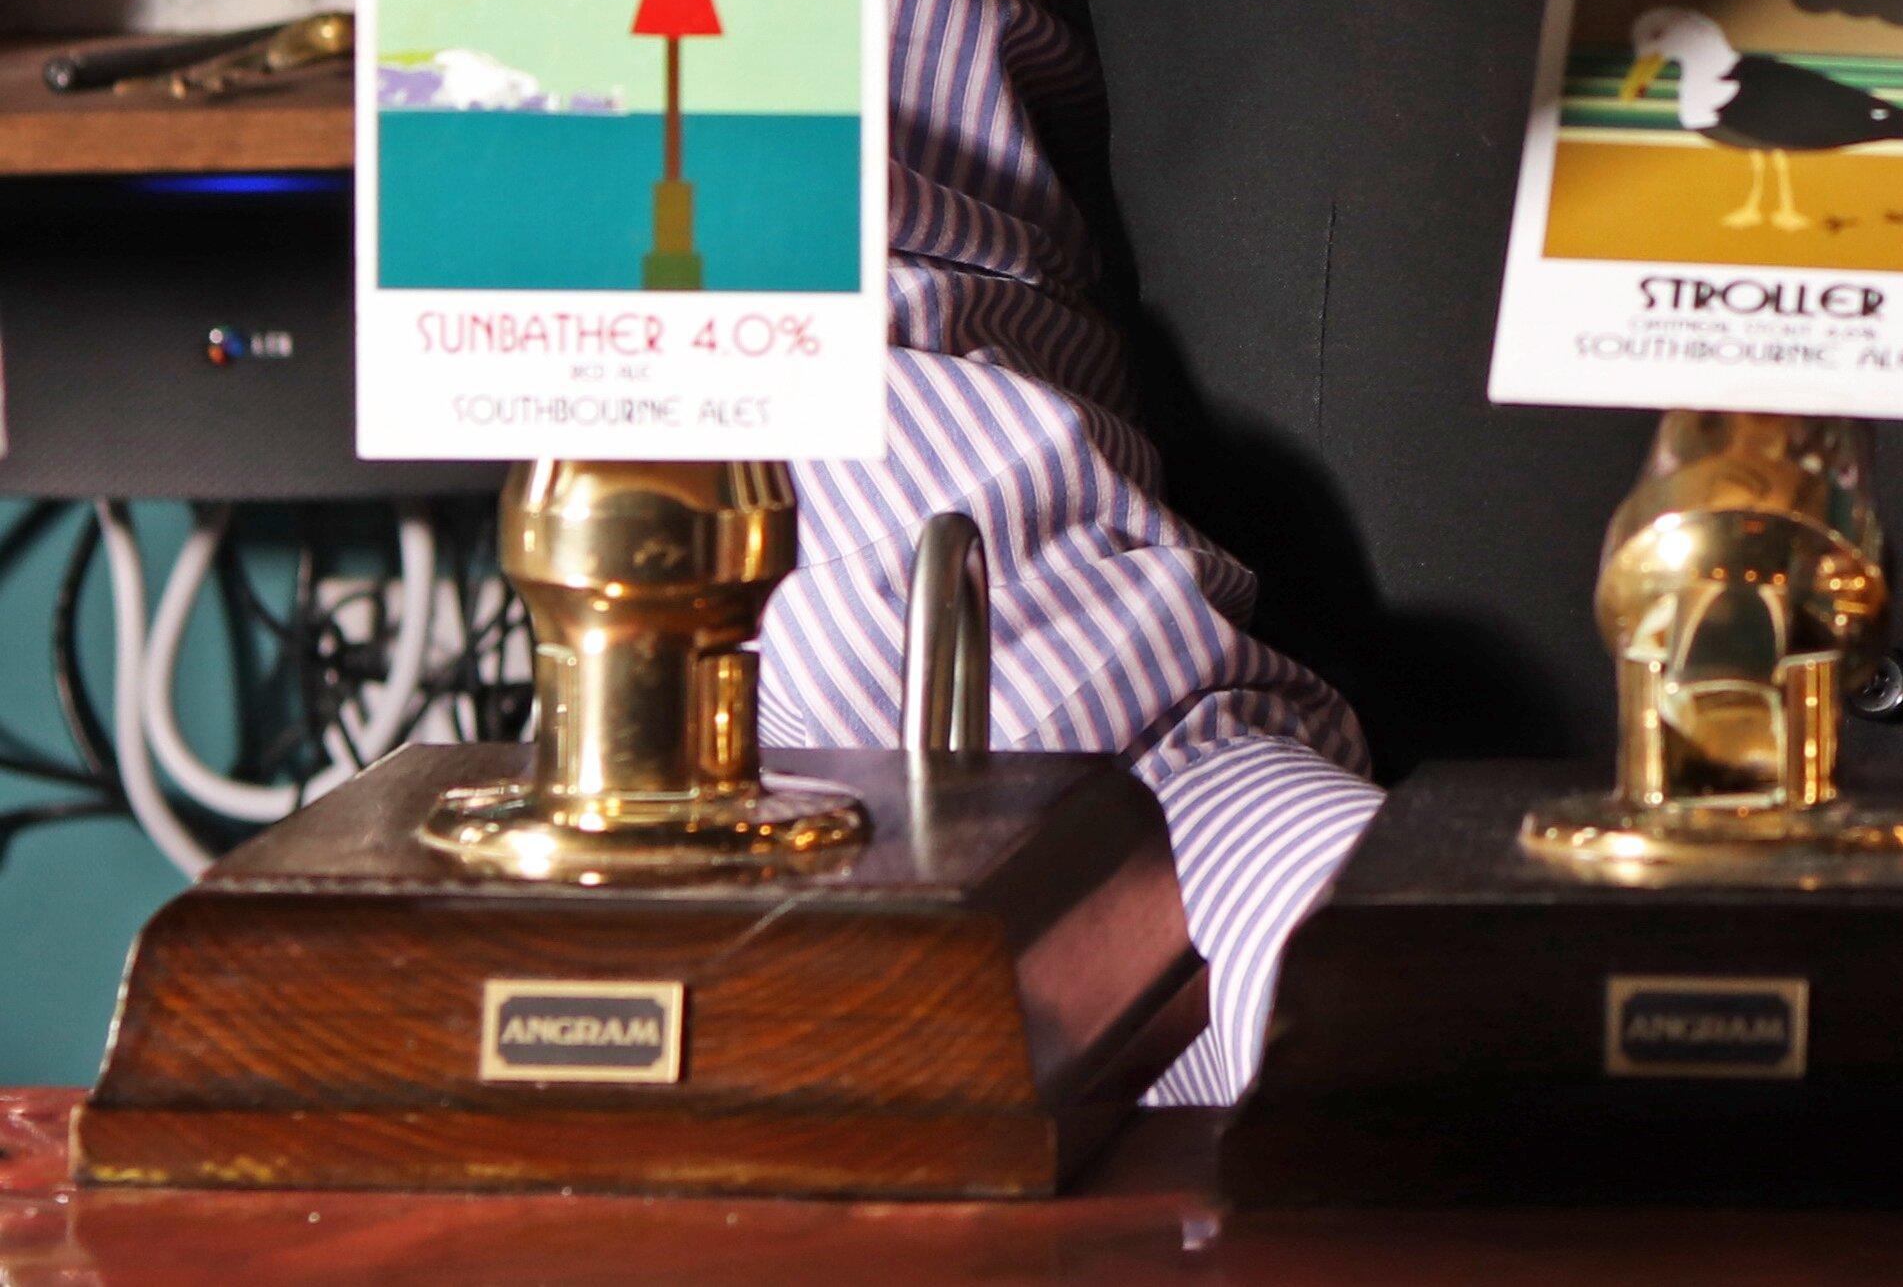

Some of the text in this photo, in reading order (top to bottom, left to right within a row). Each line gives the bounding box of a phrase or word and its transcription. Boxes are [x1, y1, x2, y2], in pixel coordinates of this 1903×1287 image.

[1639, 275, 1886, 320] STROLLER
[417, 310, 822, 357] SUNBATHER 4.0%
[1573, 331, 1831, 367] SOUTHBOURNE
[451, 393, 771, 427] SOUTHBOURNE ALES
[501, 1014, 661, 1047] ANGRAM
